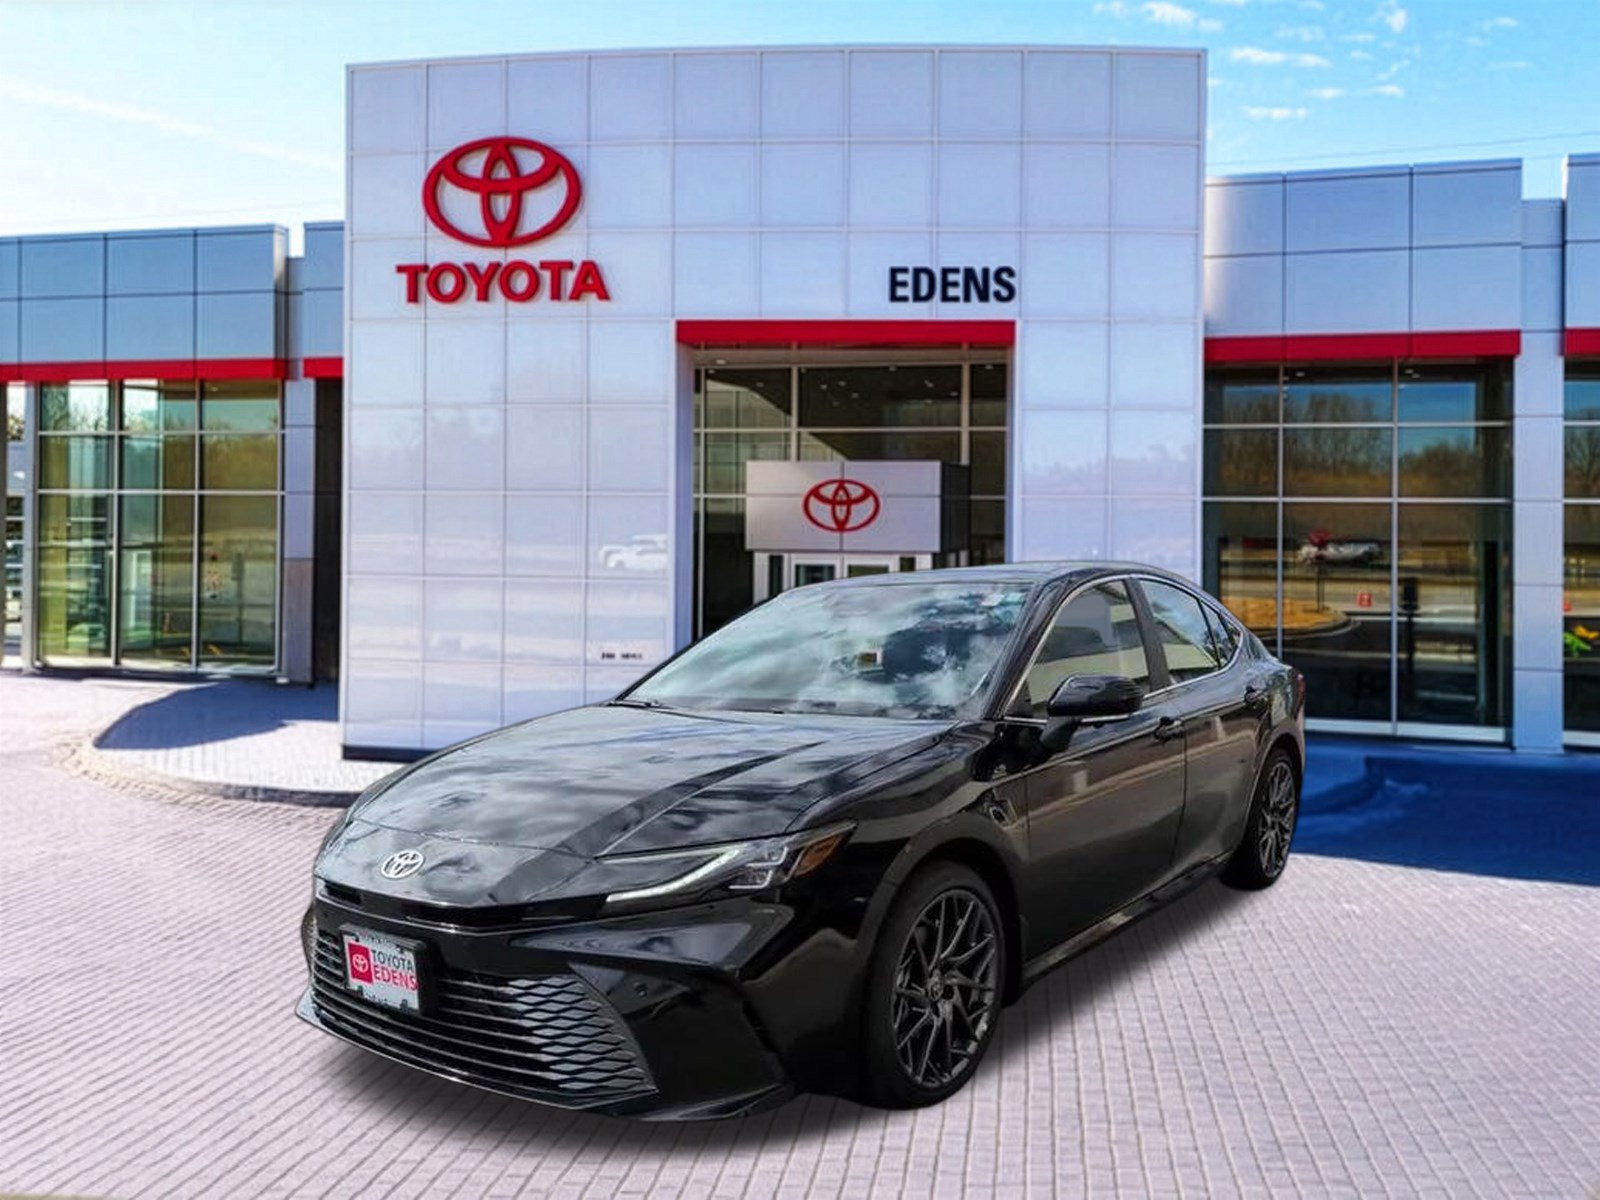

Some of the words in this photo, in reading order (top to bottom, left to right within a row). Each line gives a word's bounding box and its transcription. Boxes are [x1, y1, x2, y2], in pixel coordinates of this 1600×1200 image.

[396, 260, 610, 304] TOYOTA
[889, 266, 1016, 304] EDENS
[372, 949, 413, 972] TOYOTA
[373, 964, 419, 991] EDENS
